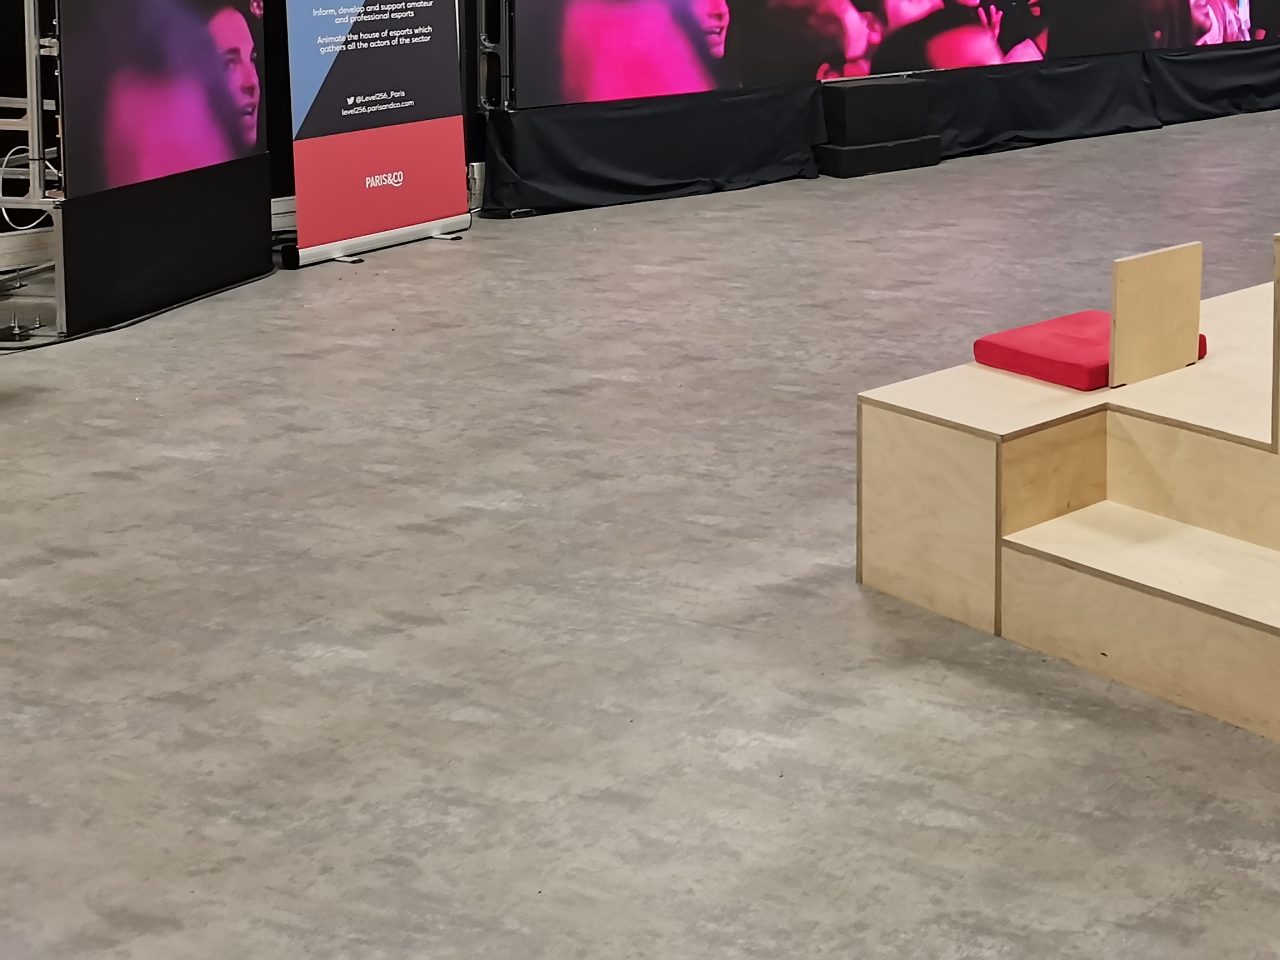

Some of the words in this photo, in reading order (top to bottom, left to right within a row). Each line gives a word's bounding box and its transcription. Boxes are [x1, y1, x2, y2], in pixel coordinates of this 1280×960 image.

[312, 8, 337, 17] Inform,
[338, 5, 365, 15] develop
[366, 3, 379, 12] and
[380, 2, 406, 12] support
[406, 0, 434, 9] amateur
[334, 15, 349, 24] and
[349, 11, 390, 24] professional
[390, 10, 415, 20] esports
[316, 35, 346, 44] Animate
[347, 32, 359, 41] the
[360, 31, 380, 39] house
[381, 29, 388, 38] of
[389, 27, 413, 37] esports
[414, 25, 433, 34] which
[320, 44, 346, 55] gathers
[347, 42, 356, 50] all
[357, 41, 369, 49] the
[369, 40, 391, 48] actors
[391, 37, 398, 46] of
[400, 37, 411, 45] the
[411, 35, 431, 44] sector
[365, 171, 404, 189] PARIS&CO
